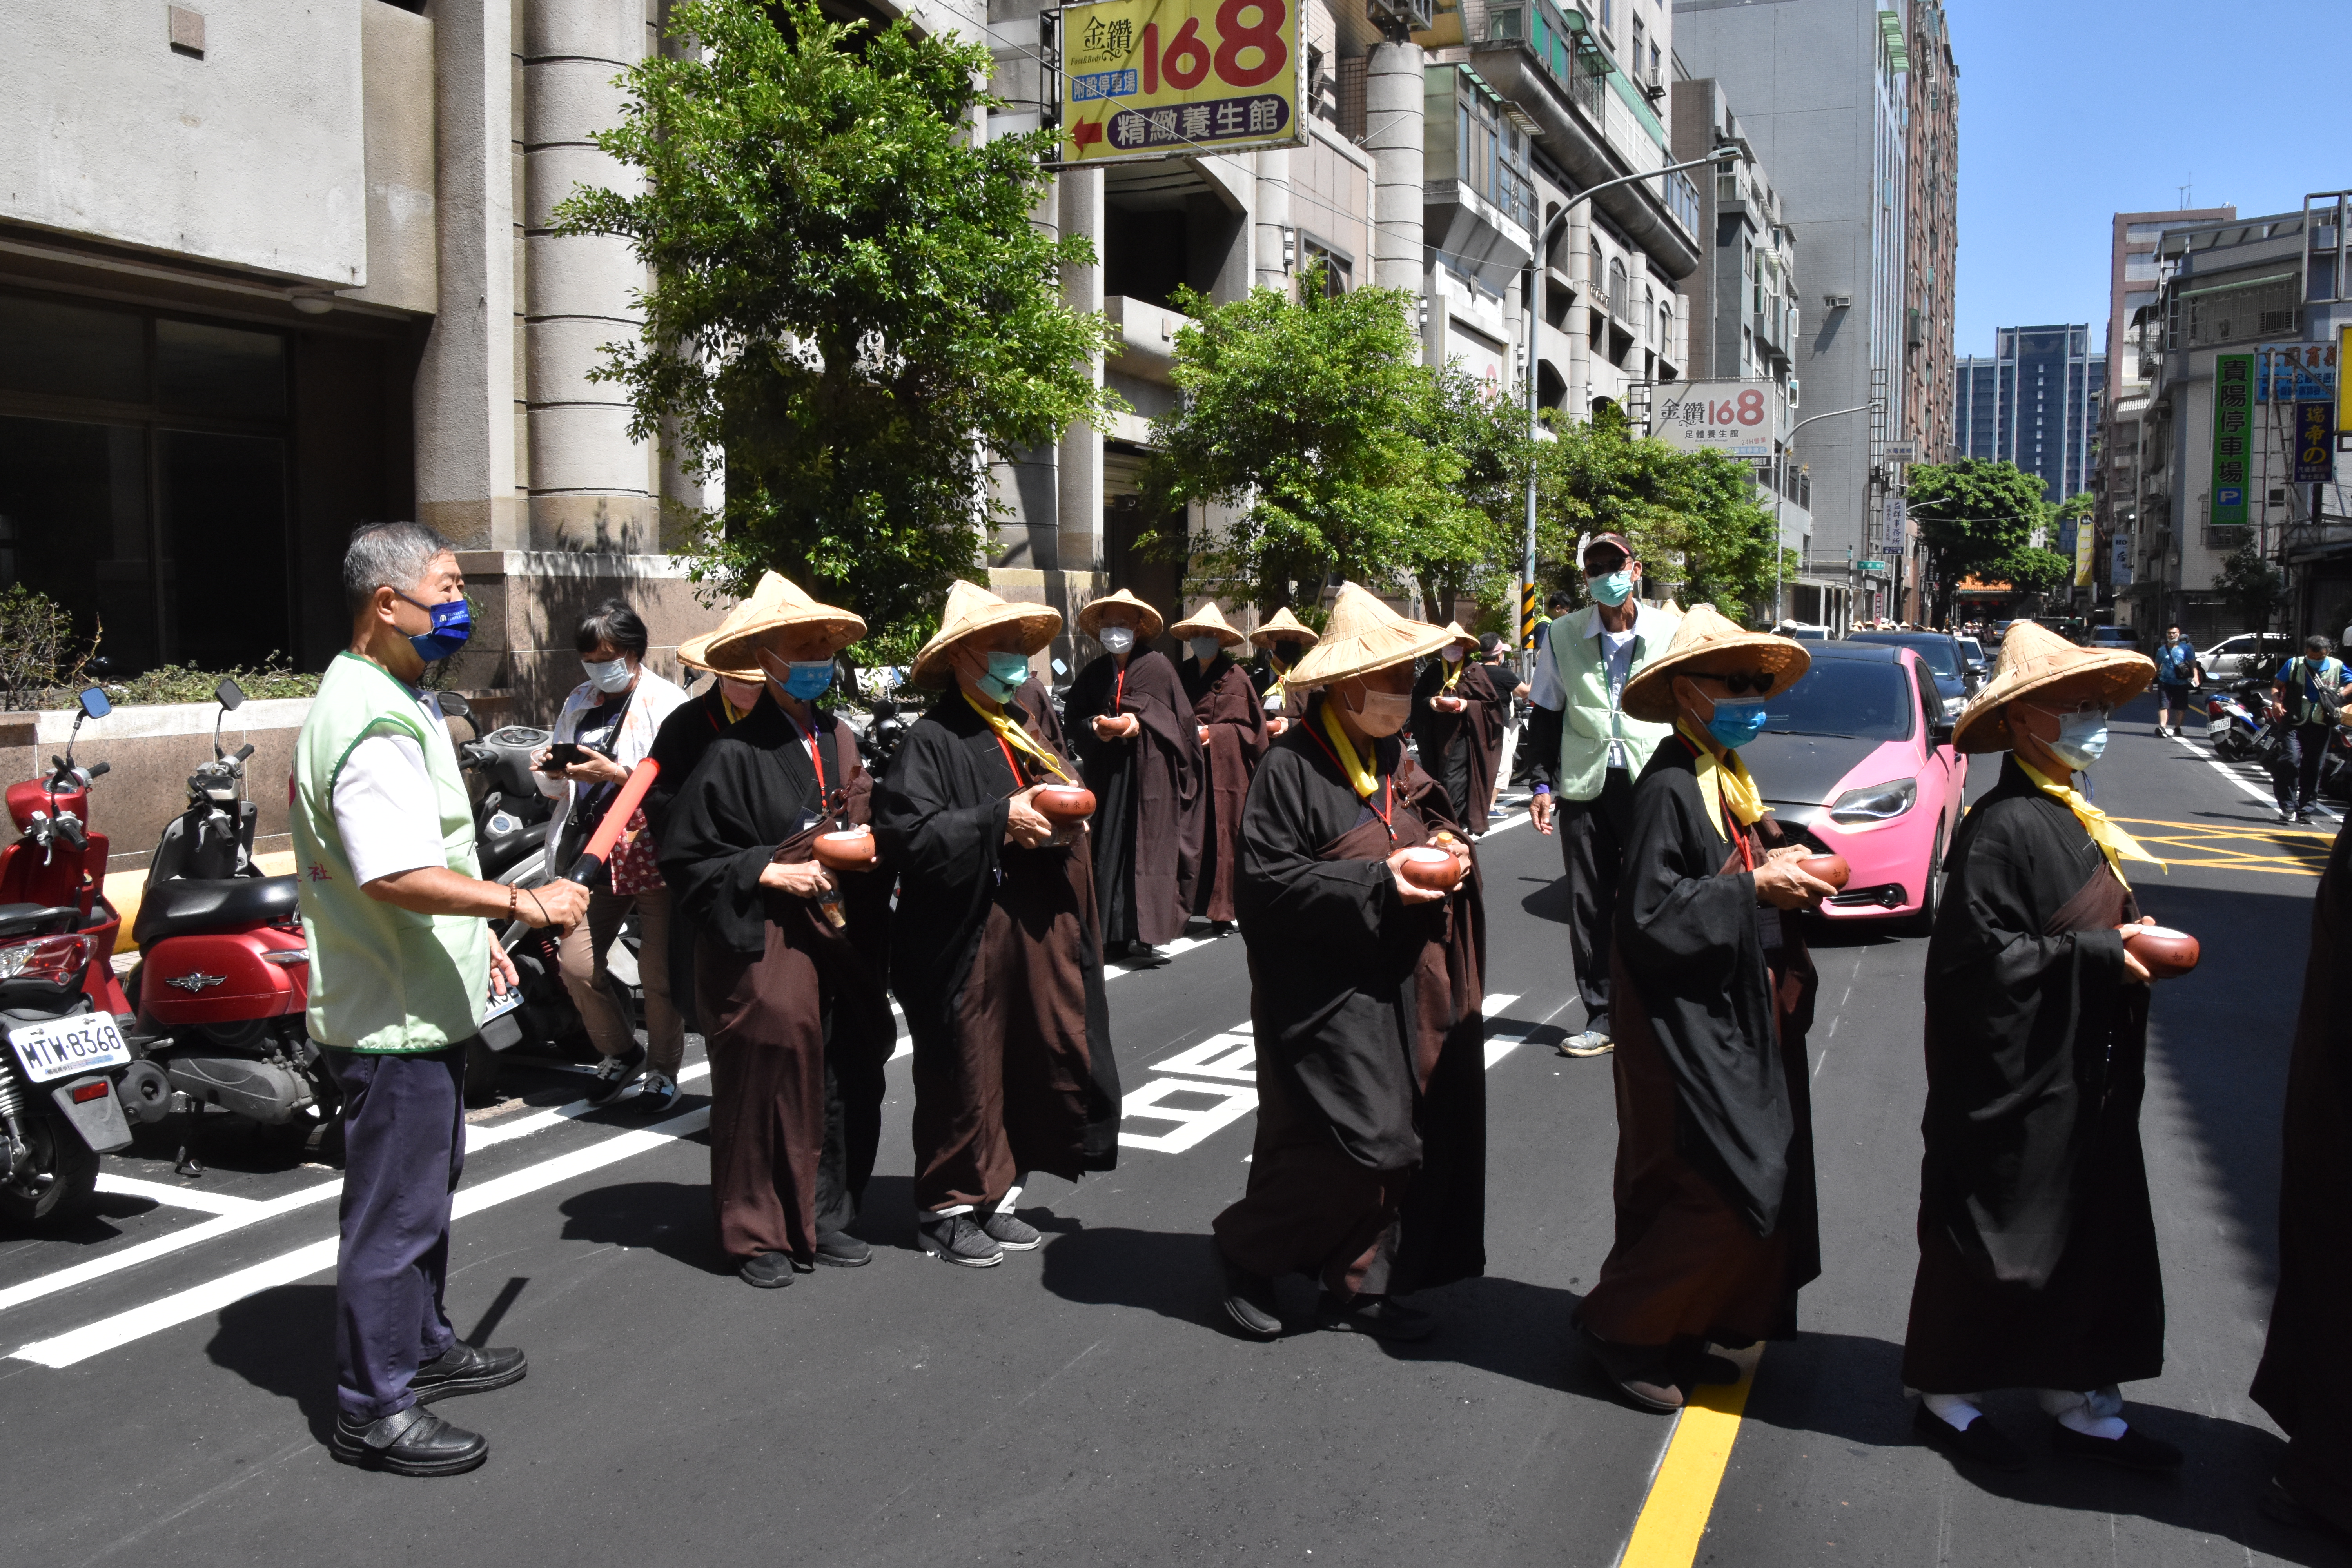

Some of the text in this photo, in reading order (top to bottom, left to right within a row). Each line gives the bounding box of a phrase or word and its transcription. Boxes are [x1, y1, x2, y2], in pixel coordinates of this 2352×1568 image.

[1143, 0, 1287, 95] 168
[1074, 71, 1136, 99] 附設停車場
[1117, 99, 1278, 146] 精緻養生館
[1685, 429, 1739, 439] 足體養生館
[2218, 359, 2248, 484] 貴陽停車場
[2221, 491, 2239, 502] P
[296, 860, 333, 882] 社
